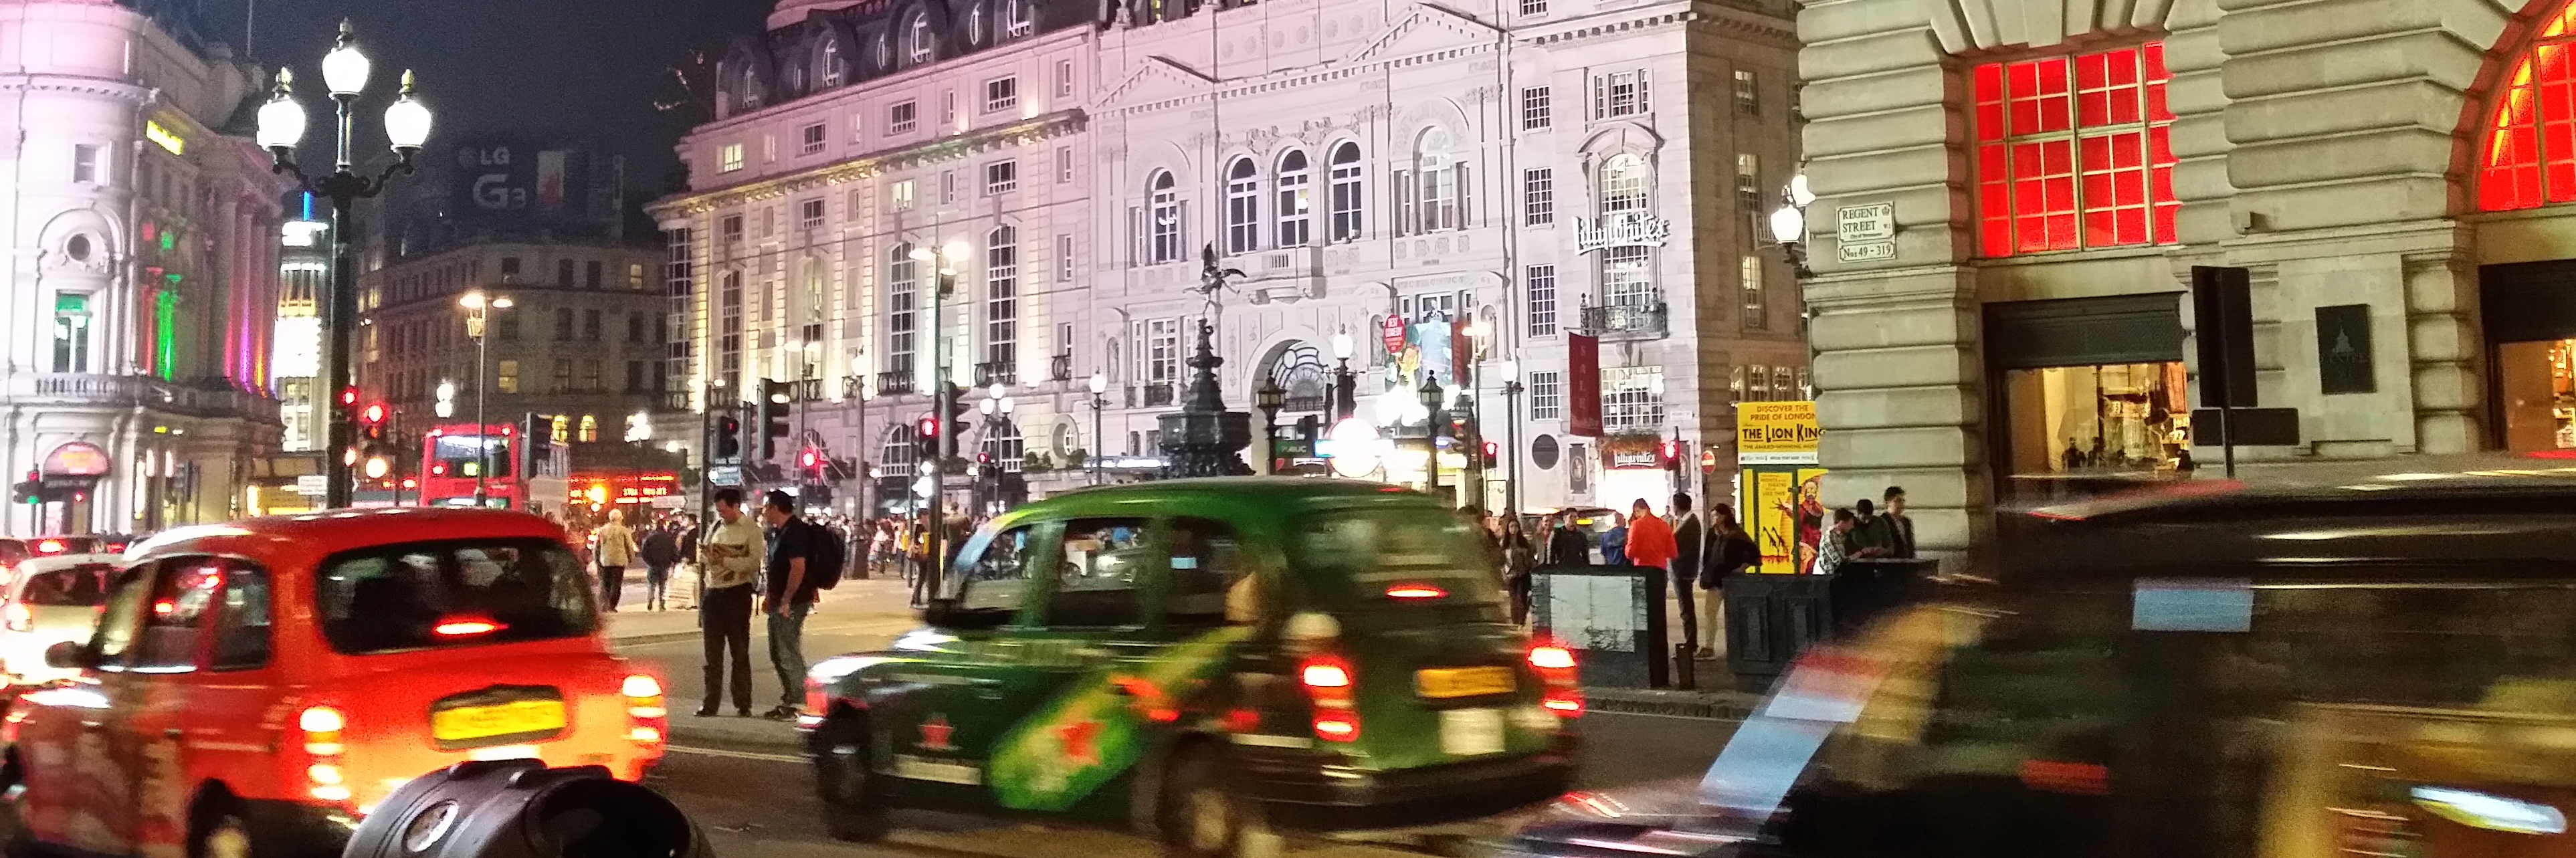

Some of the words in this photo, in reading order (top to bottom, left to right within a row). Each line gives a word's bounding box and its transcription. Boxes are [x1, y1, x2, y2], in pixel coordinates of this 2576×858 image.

[480, 146, 511, 166] LG
[472, 173, 526, 209] G3
[1842, 207, 1878, 219] REGENT
[1842, 221, 1876, 233] STREET
[1844, 248, 1857, 258] Nos
[1858, 247, 1868, 257] 49
[1876, 245, 1891, 255] 319
[1579, 344, 1587, 409] SALE
[1757, 405, 1793, 413] DISCOVER
[1742, 428, 1763, 439] THE
[1765, 424, 1793, 443] LION
